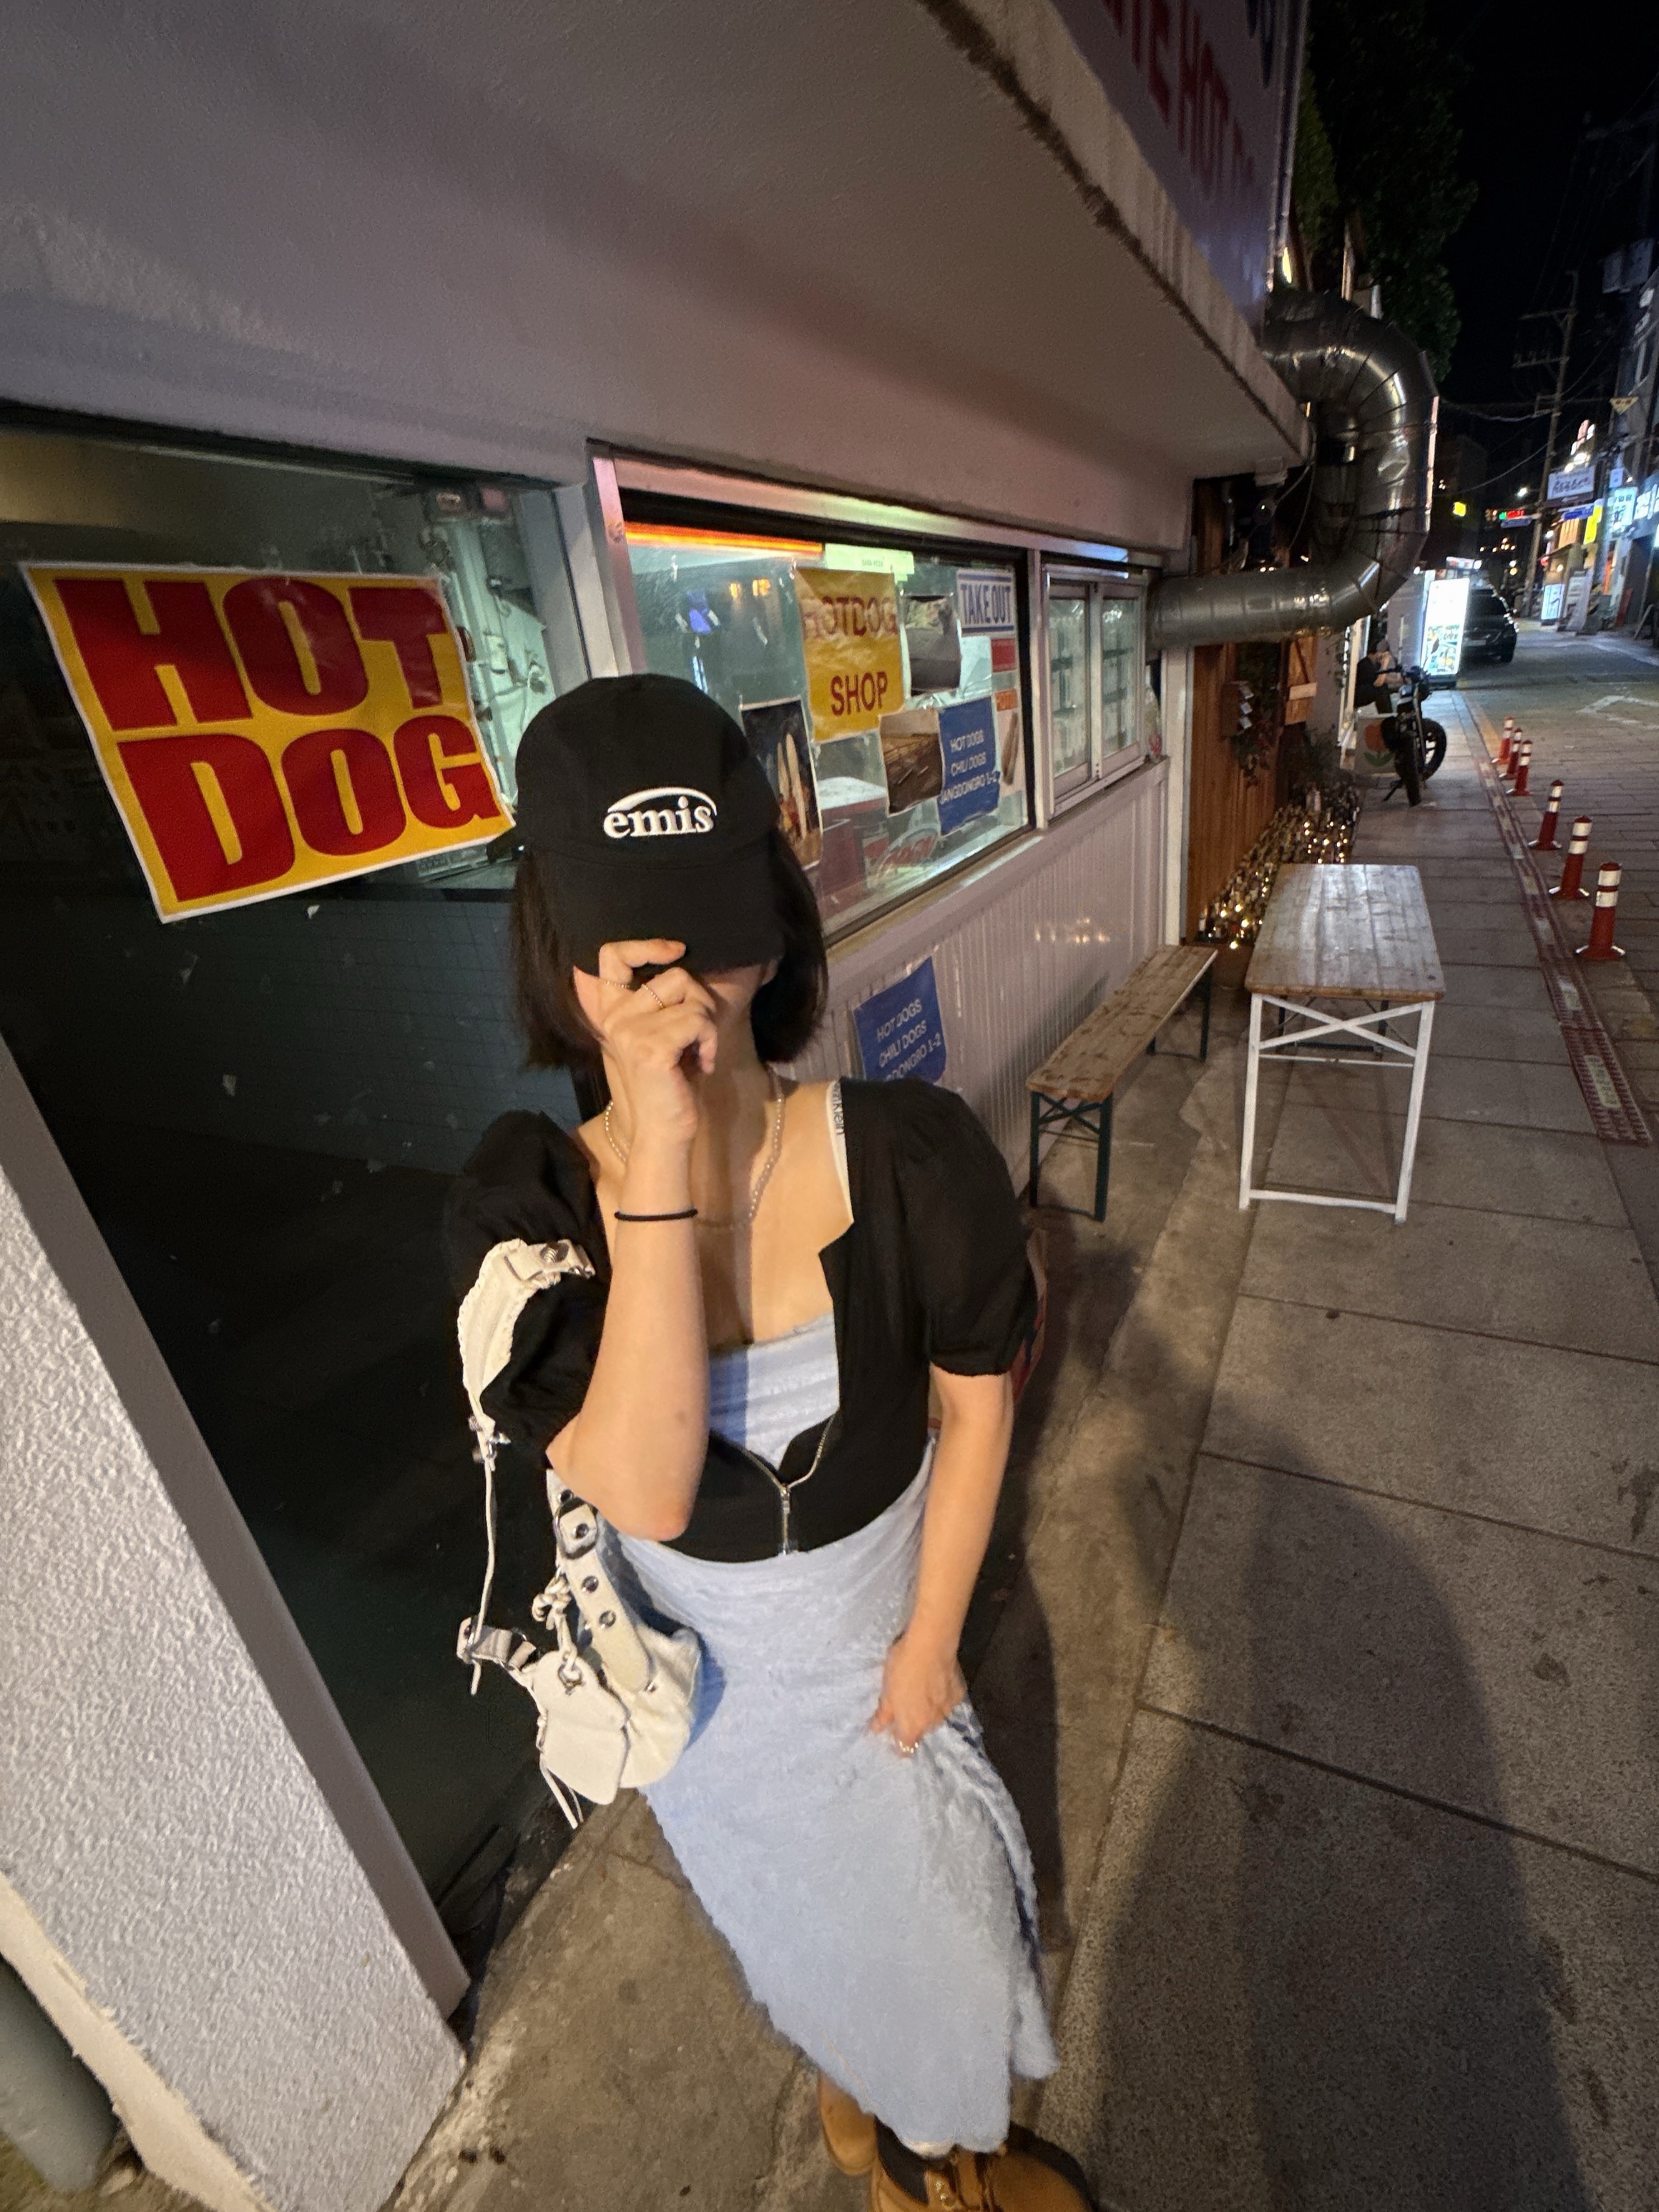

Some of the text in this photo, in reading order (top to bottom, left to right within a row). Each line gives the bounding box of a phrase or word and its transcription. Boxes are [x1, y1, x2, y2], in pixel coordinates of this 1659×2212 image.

[53, 577, 447, 731] HOT
[830, 671, 888, 716] SHOP
[950, 729, 984, 752] HOT DOGS
[951, 752, 986, 776] CHILI DOGS
[118, 715, 499, 902] DOG
[603, 794, 714, 838] emis
[876, 997, 922, 1043] HOT DOGS
[928, 1032, 942, 1053] 1-2
[879, 1019, 927, 1068] CHILI DOGS
